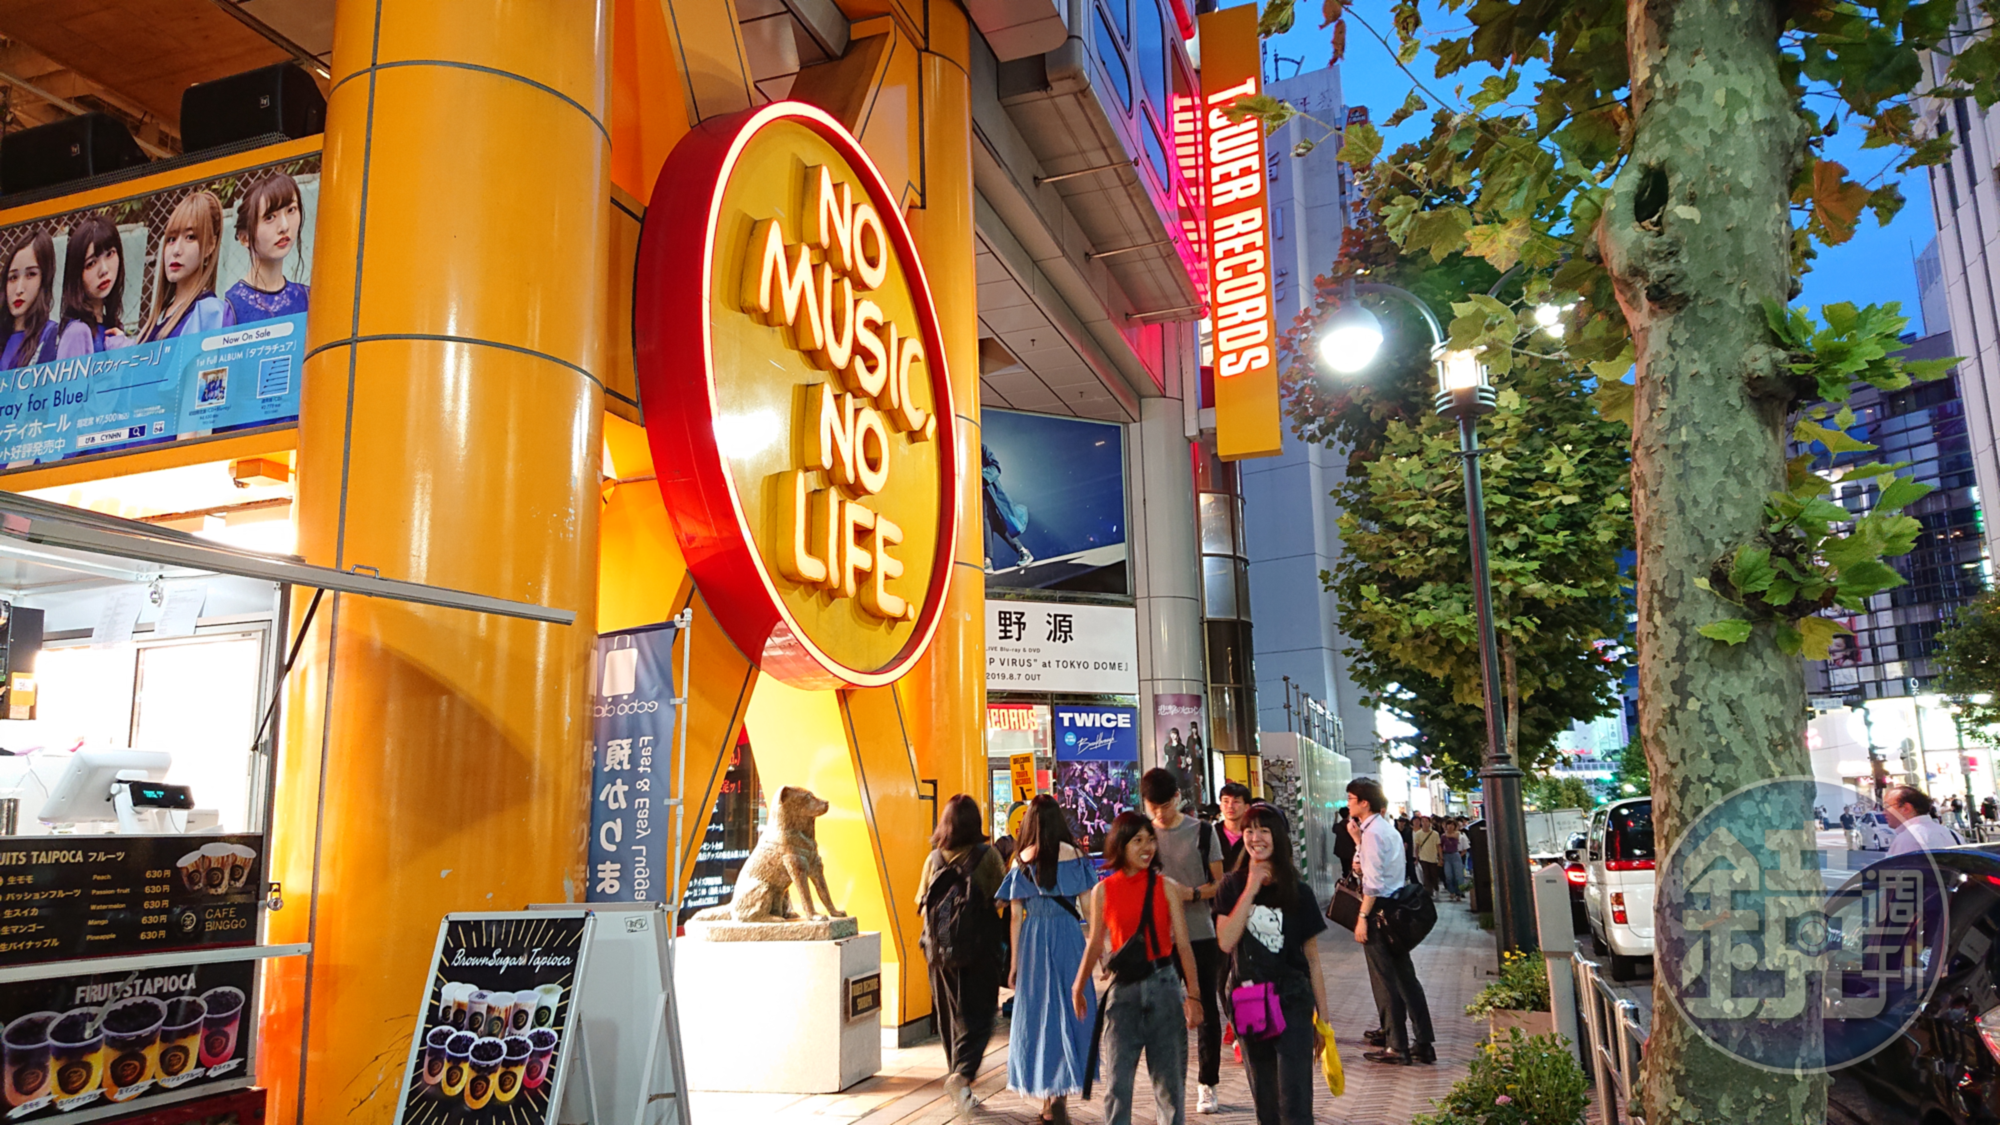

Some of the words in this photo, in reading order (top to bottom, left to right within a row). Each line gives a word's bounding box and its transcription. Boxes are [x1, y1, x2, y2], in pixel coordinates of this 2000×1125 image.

[818, 164, 888, 290] NO
[1212, 206, 1270, 378] RECORDS
[222, 336, 240, 346] Now
[241, 333, 253, 342] On
[255, 328, 271, 339] Sale
[218, 351, 243, 364] ALBUM
[27, 393, 48, 413] for
[100, 431, 122, 442] CYNHN
[820, 382, 890, 495] NO
[795, 468, 915, 622] LIFE.
[1041, 660, 1052, 669] at
[1055, 659, 1090, 670] TOKYO
[1024, 673, 1041, 681] OUT
[1058, 712, 1131, 728] TWICE
[31, 850, 84, 864] TAIPOCA
[88, 851, 126, 862] フルーツ
[145, 869, 171, 879] 630円
[144, 884, 170, 894] 630円
[90, 903, 126, 911] Watermelon
[143, 899, 169, 910] 630円
[205, 907, 237, 919] CAFE
[141, 915, 168, 925] 630円
[86, 933, 116, 941] Pineapple
[140, 930, 166, 940] 630円
[528, 947, 574, 974] Tapioca
